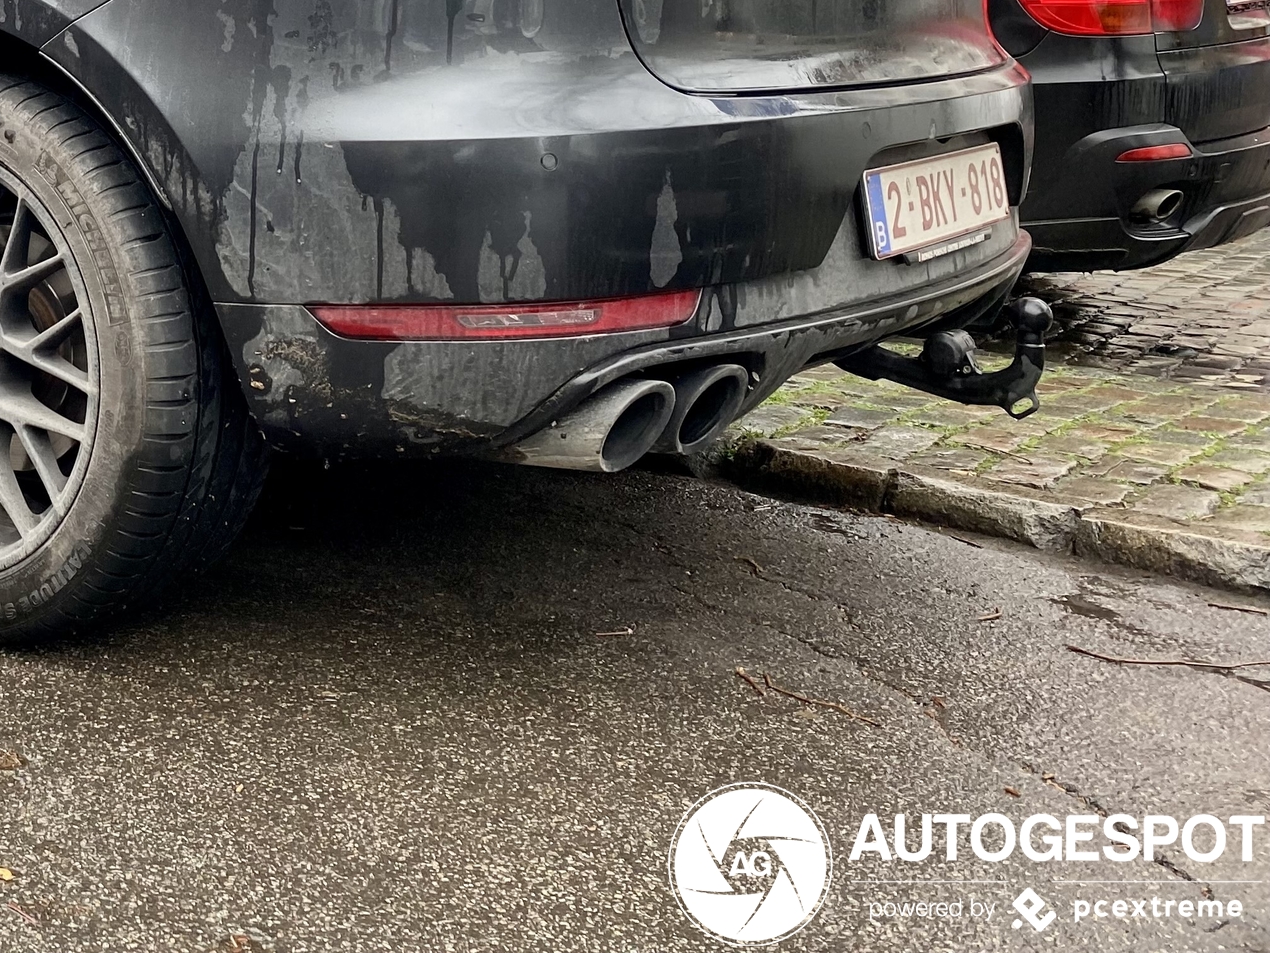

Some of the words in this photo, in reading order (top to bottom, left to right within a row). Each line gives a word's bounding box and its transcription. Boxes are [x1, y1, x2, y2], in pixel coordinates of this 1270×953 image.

[875, 221, 887, 247] B
[887, 157, 1003, 239] 2-BKY-818
[56, 179, 128, 321] MICHELIN
